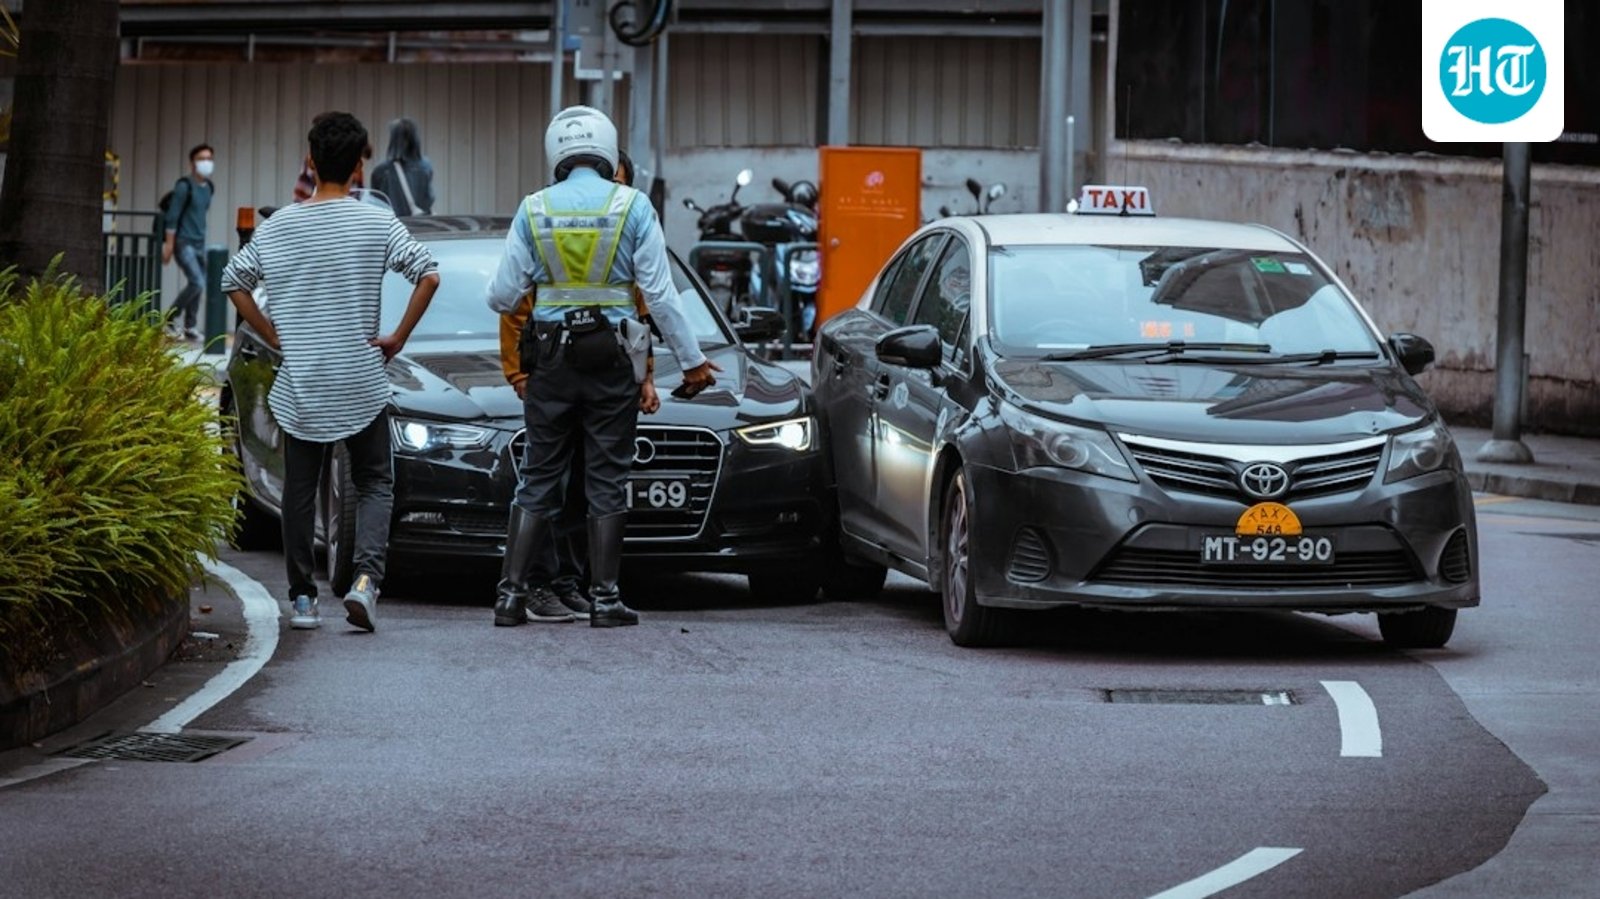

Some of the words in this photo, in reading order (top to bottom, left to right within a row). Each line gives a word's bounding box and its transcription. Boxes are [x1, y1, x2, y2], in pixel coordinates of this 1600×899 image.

[1088, 190, 1145, 209] TAXI
[1249, 508, 1289, 523] TAXI
[1257, 524, 1283, 534] 548
[1204, 537, 1332, 561] MT-92-90
